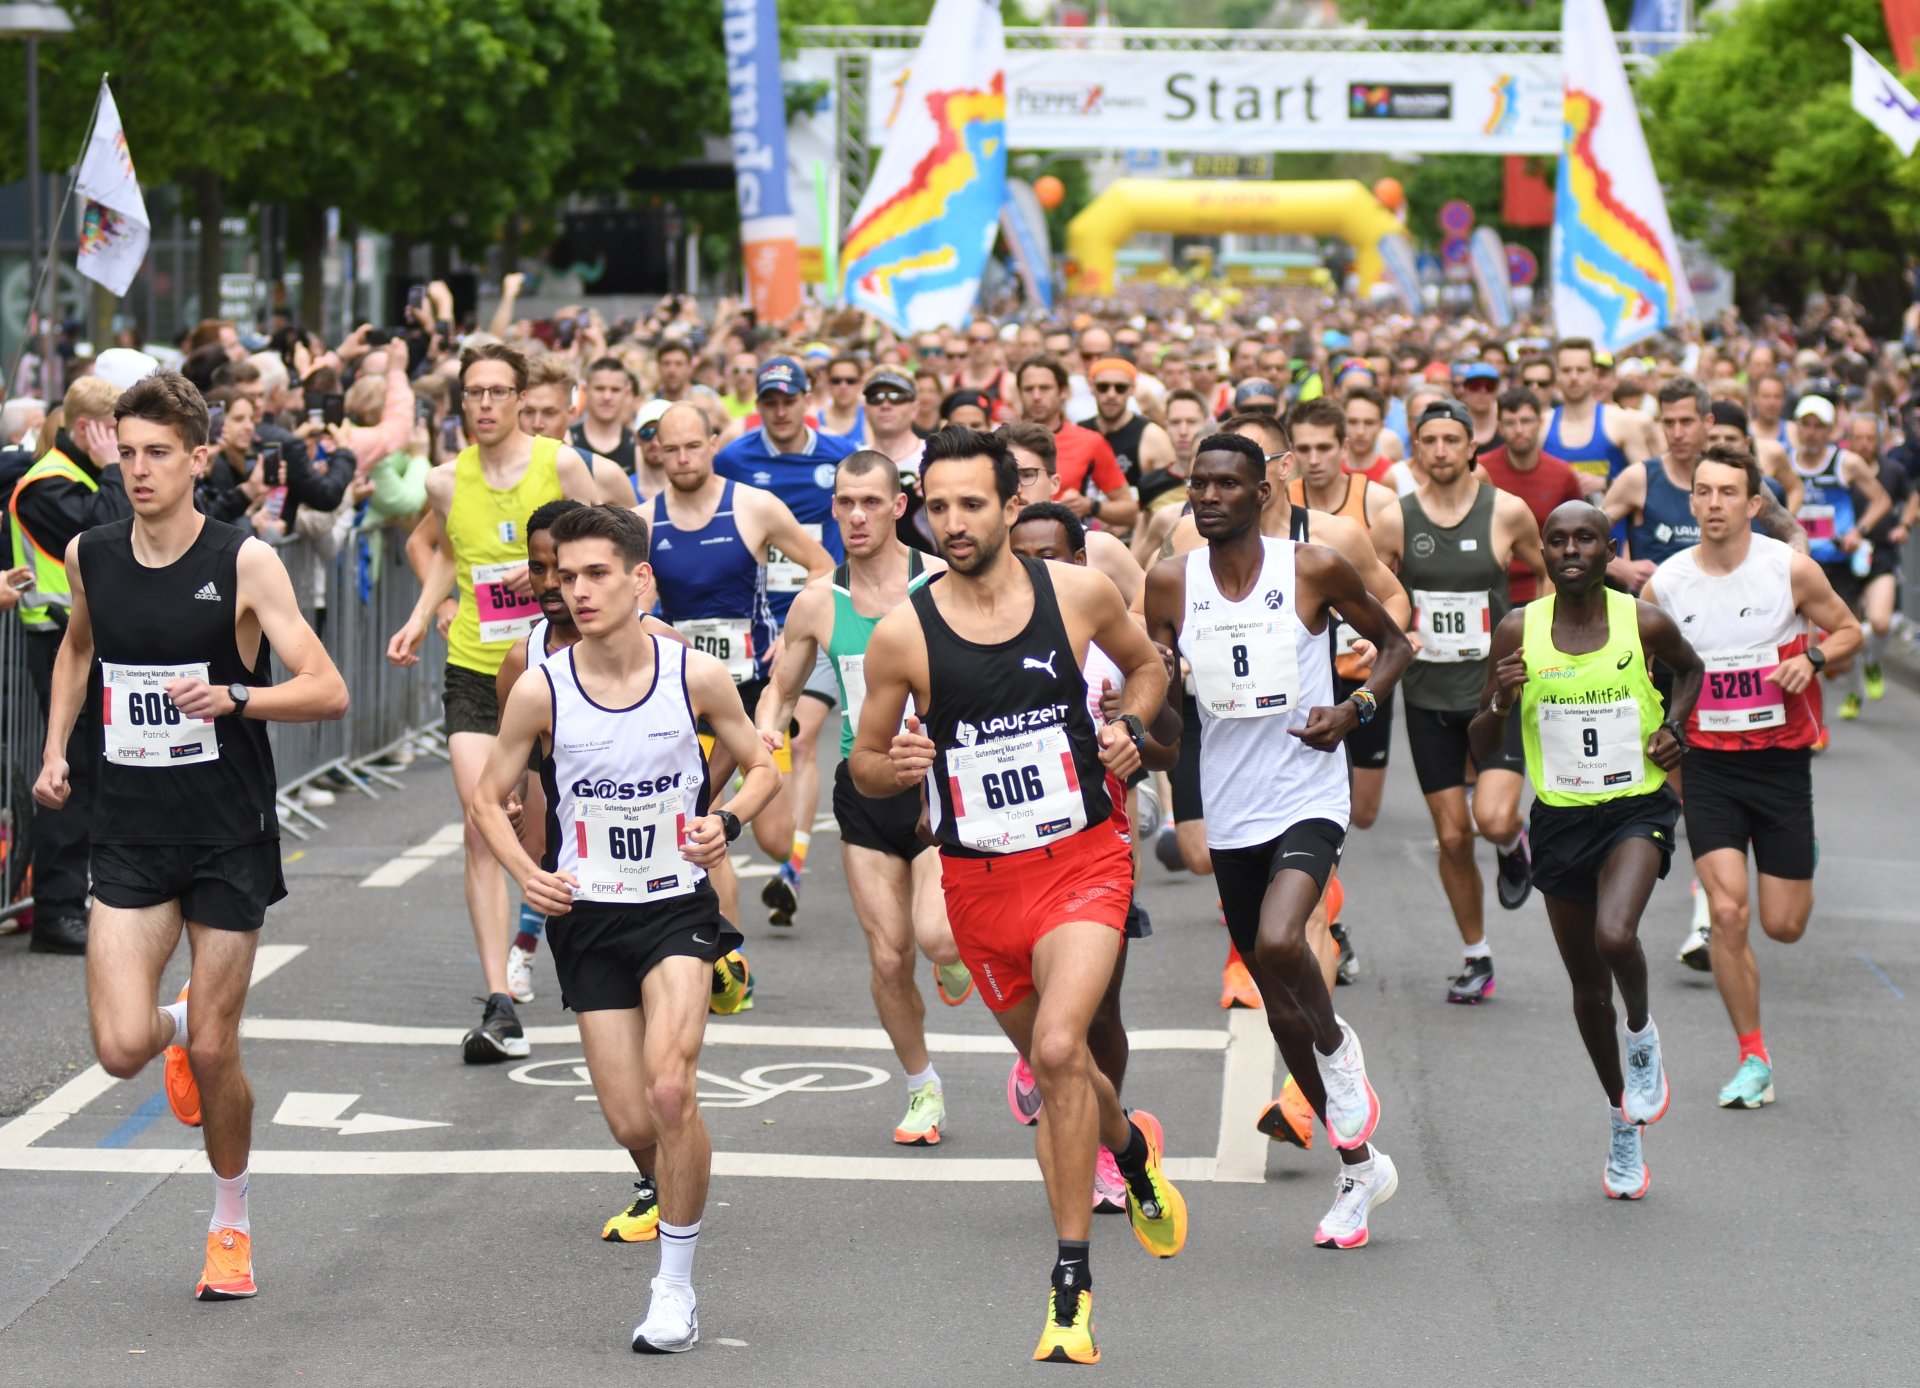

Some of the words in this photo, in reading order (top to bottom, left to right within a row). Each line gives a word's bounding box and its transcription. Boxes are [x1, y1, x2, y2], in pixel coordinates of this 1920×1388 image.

[1164, 72, 1321, 122] Start
[194, 593, 222, 601] adidas
[1214, 624, 1238, 632] Gutenberg
[1239, 622, 1264, 630] Marathon
[1433, 611, 1465, 634] 618
[1232, 644, 1250, 677] 8
[126, 670, 150, 679] Gutenberg
[1231, 681, 1257, 691] Patrick
[1710, 669, 1763, 699] 5281
[129, 692, 180, 725] 608
[1564, 708, 1589, 716] Gutenberg
[143, 730, 170, 738] Patrick
[1583, 728, 1599, 757] 9
[975, 746, 1005, 759] Gutenberg
[1005, 741, 1033, 753] Marathon
[998, 755, 1015, 764] Mainz
[1578, 761, 1607, 769] Dickson
[982, 764, 1045, 810] 606
[604, 803, 631, 814] Gutenberg
[632, 802, 656, 812] Marathon
[1005, 809, 1034, 821] Tobias
[609, 824, 656, 861] 607
[620, 864, 650, 874] Leander
[983, 963, 1003, 1001] SALOMON
